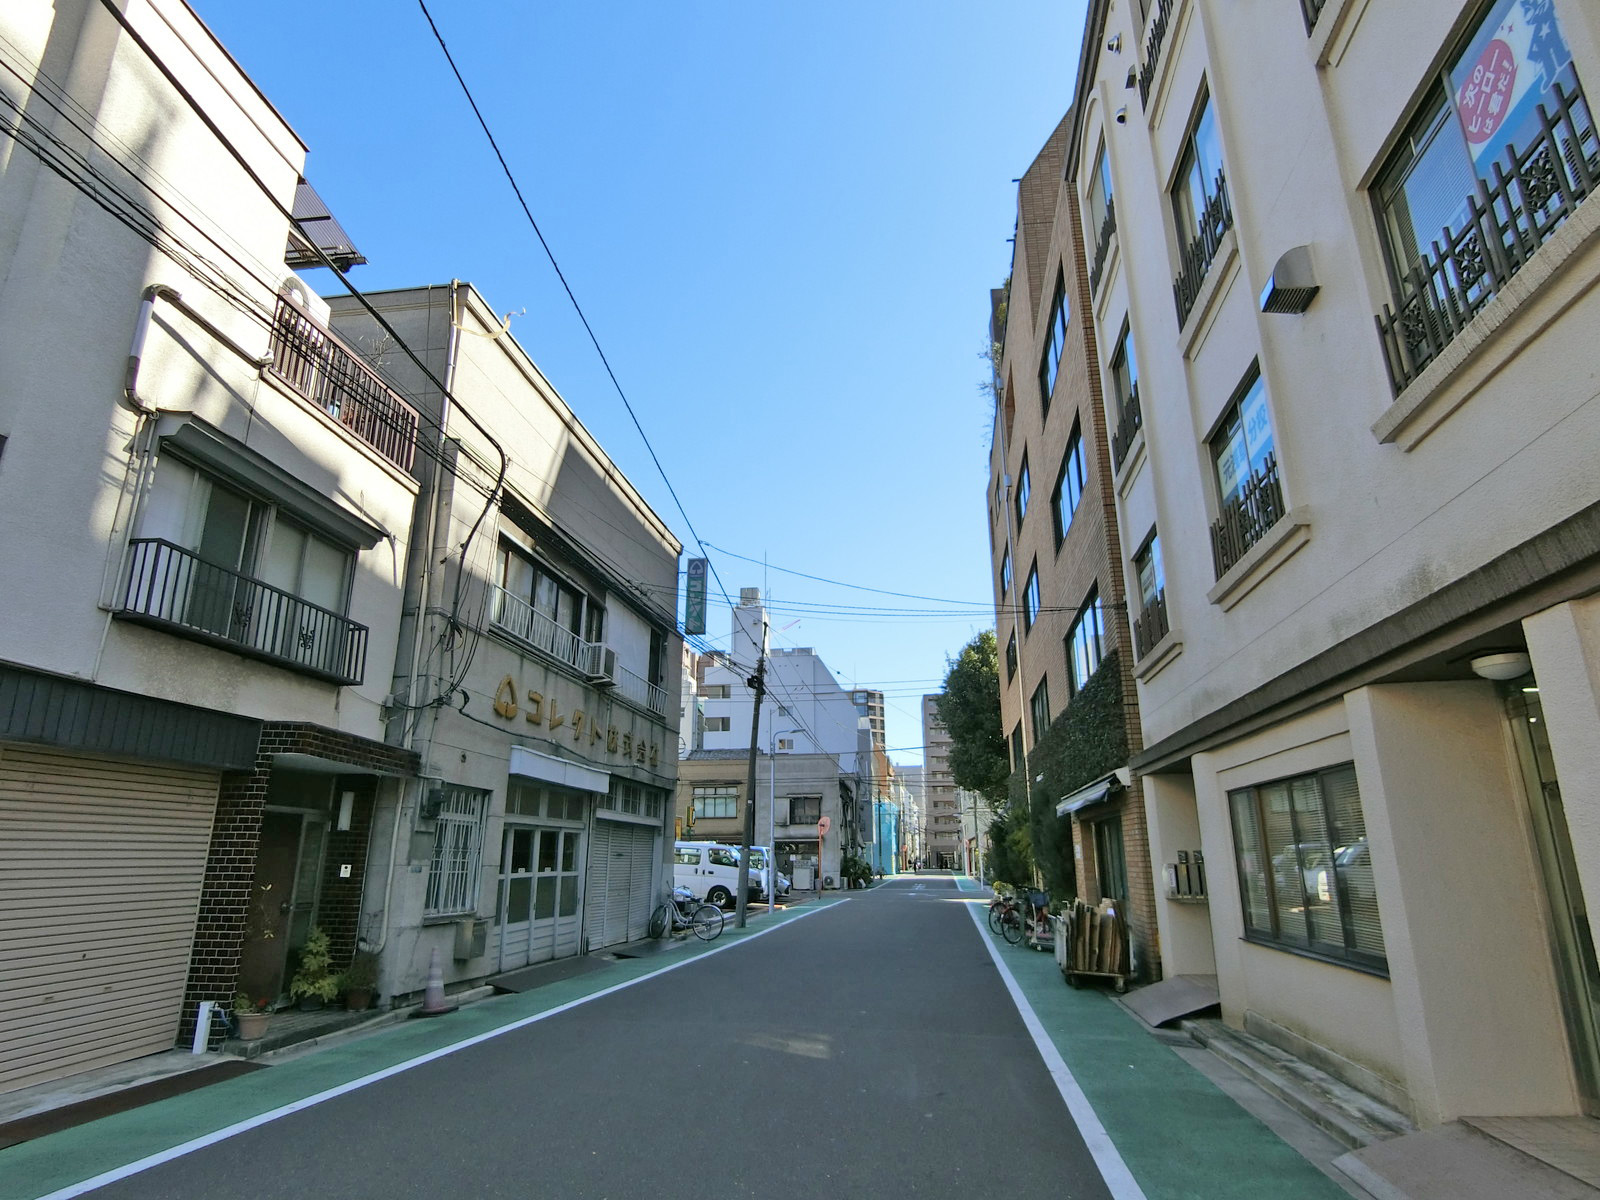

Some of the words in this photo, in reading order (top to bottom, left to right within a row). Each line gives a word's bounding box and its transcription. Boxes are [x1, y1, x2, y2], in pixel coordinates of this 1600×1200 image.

[1463, 64, 1484, 109] 次の
[1468, 48, 1499, 134] ヒーロー
